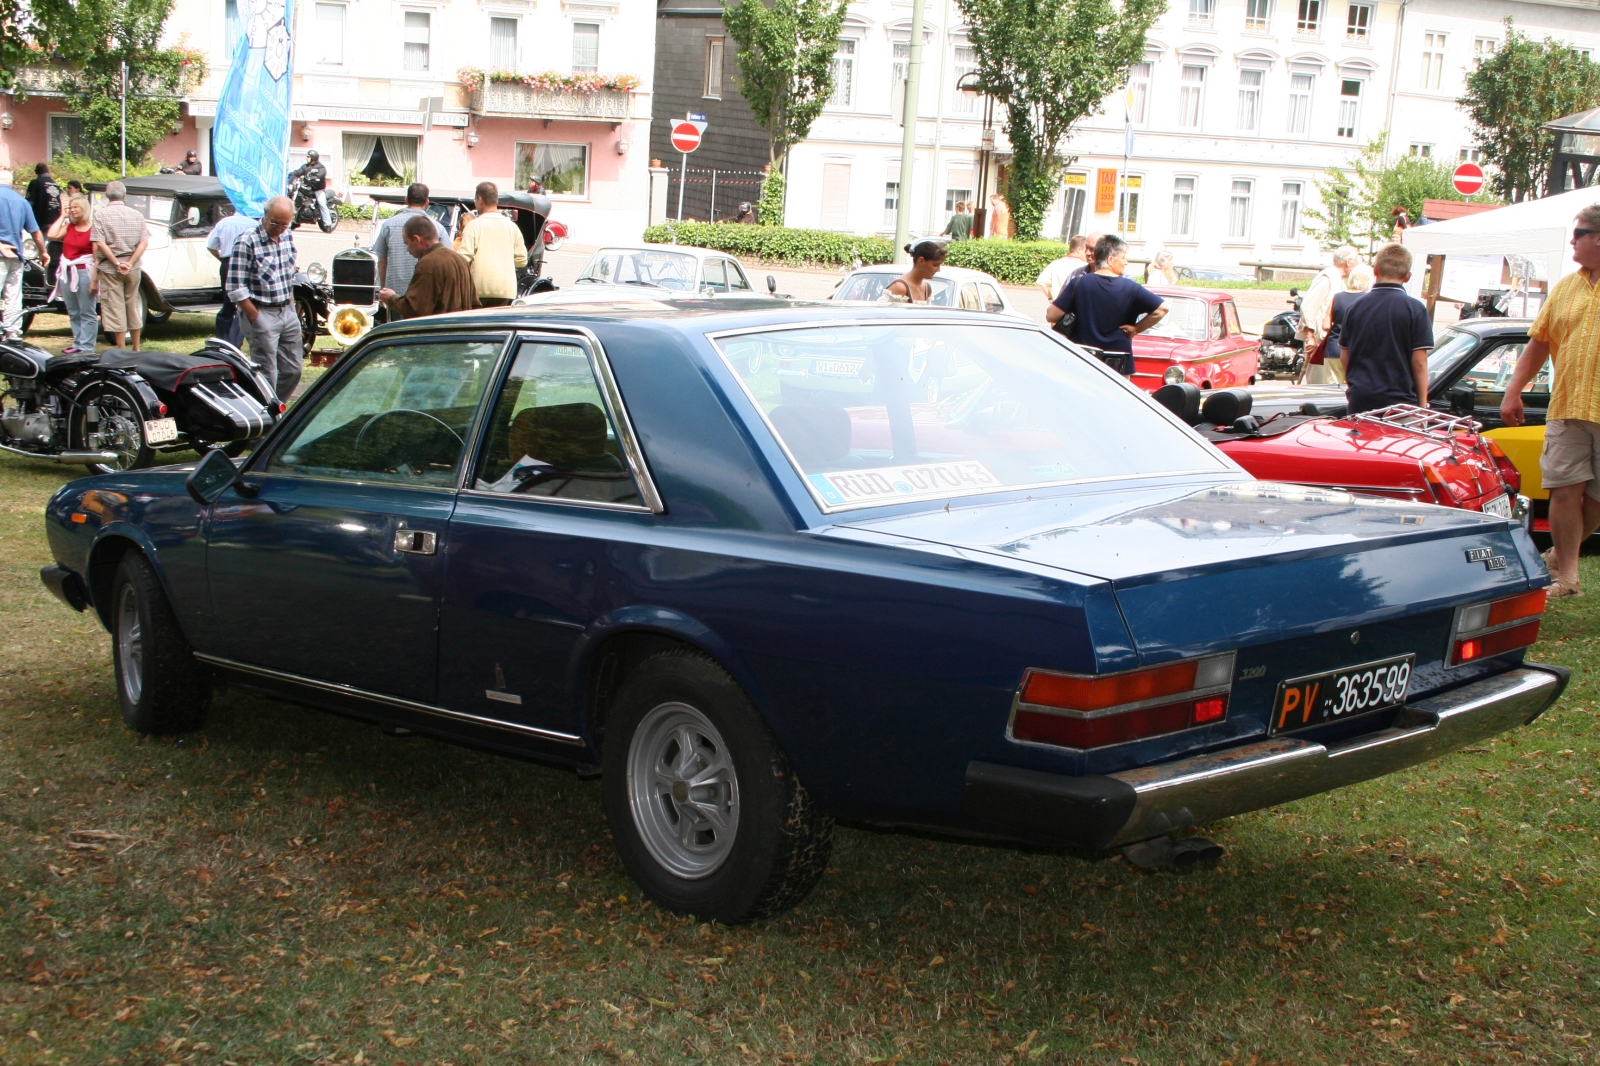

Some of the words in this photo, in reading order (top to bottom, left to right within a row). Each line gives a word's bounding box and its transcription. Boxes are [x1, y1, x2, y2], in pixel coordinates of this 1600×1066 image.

[318, 109, 394, 121] NTERNATIONALE
[1101, 171, 1117, 185] TAXI
[901, 463, 993, 490] 07043
[1470, 548, 1492, 560] FIAT
[1489, 556, 1506, 568] 130
[1278, 682, 1320, 729] PV
[1332, 662, 1410, 715] 363599
